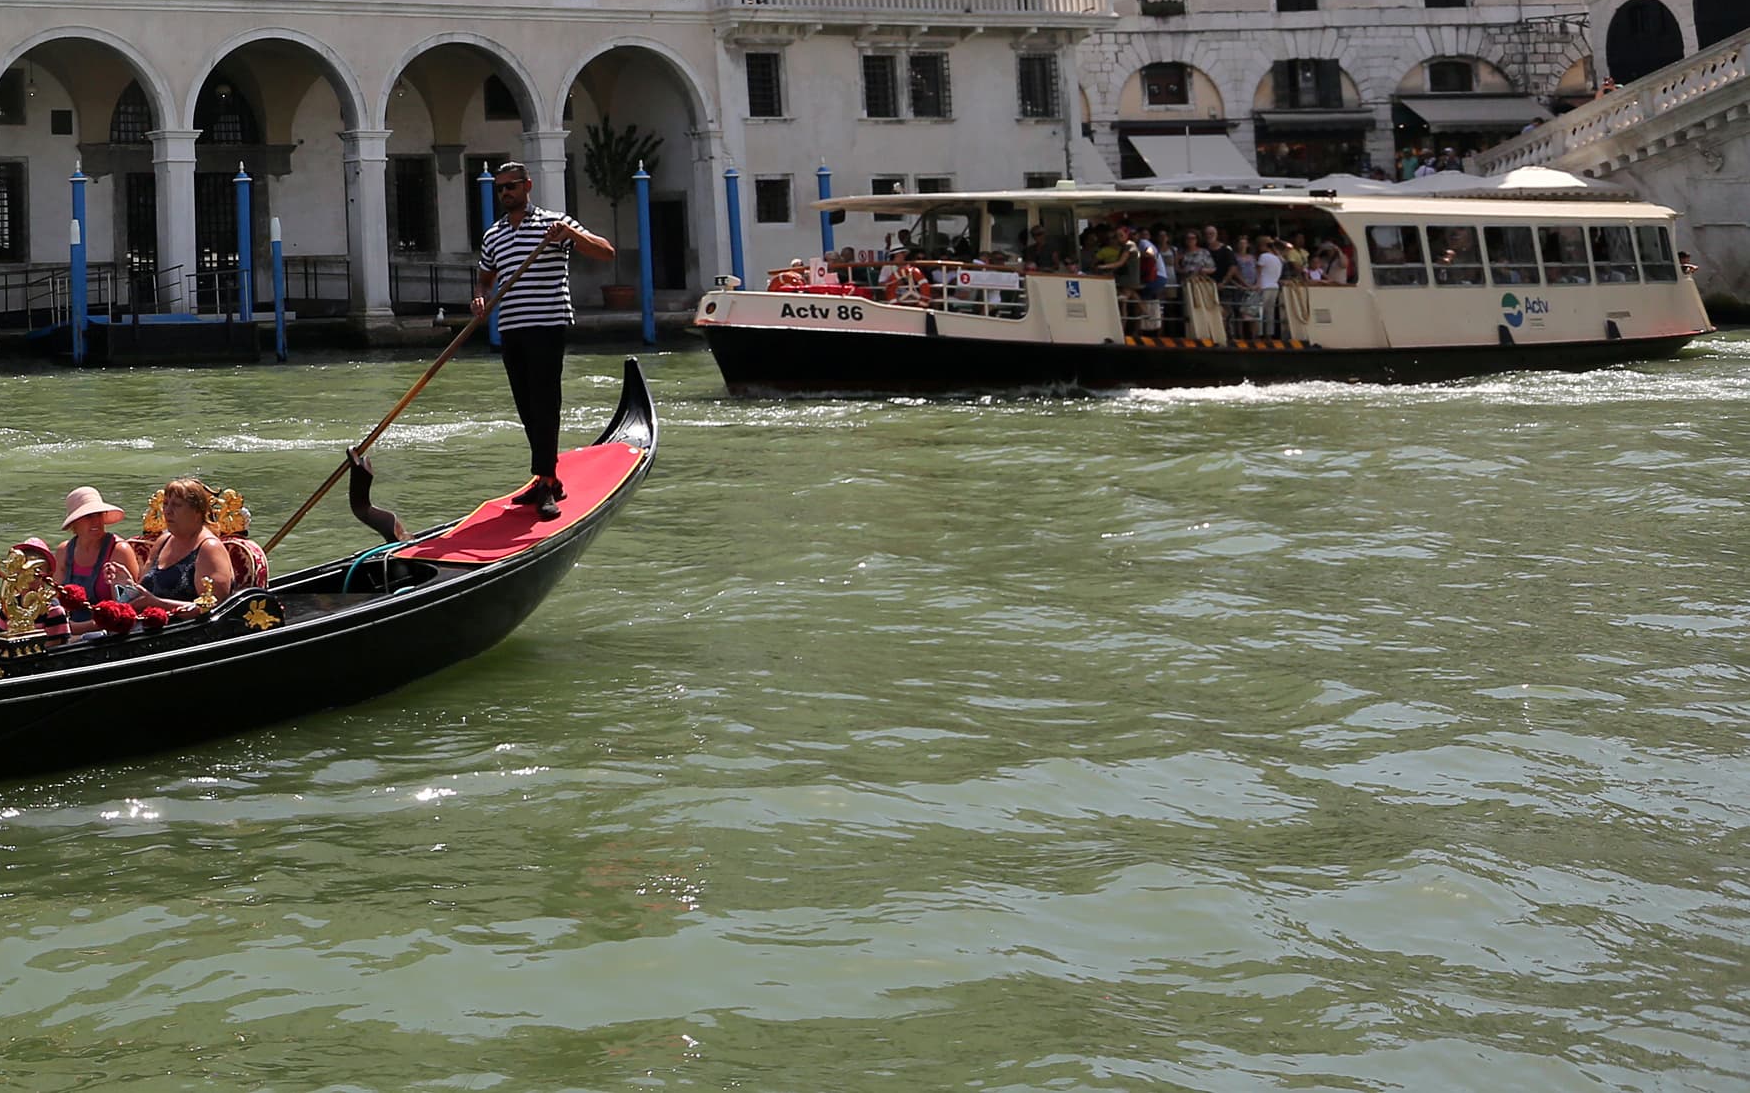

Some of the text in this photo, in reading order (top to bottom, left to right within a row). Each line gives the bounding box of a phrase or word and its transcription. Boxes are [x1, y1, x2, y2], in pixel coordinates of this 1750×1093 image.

[781, 303, 863, 321] Actv 86
[1525, 297, 1548, 313] Actv
